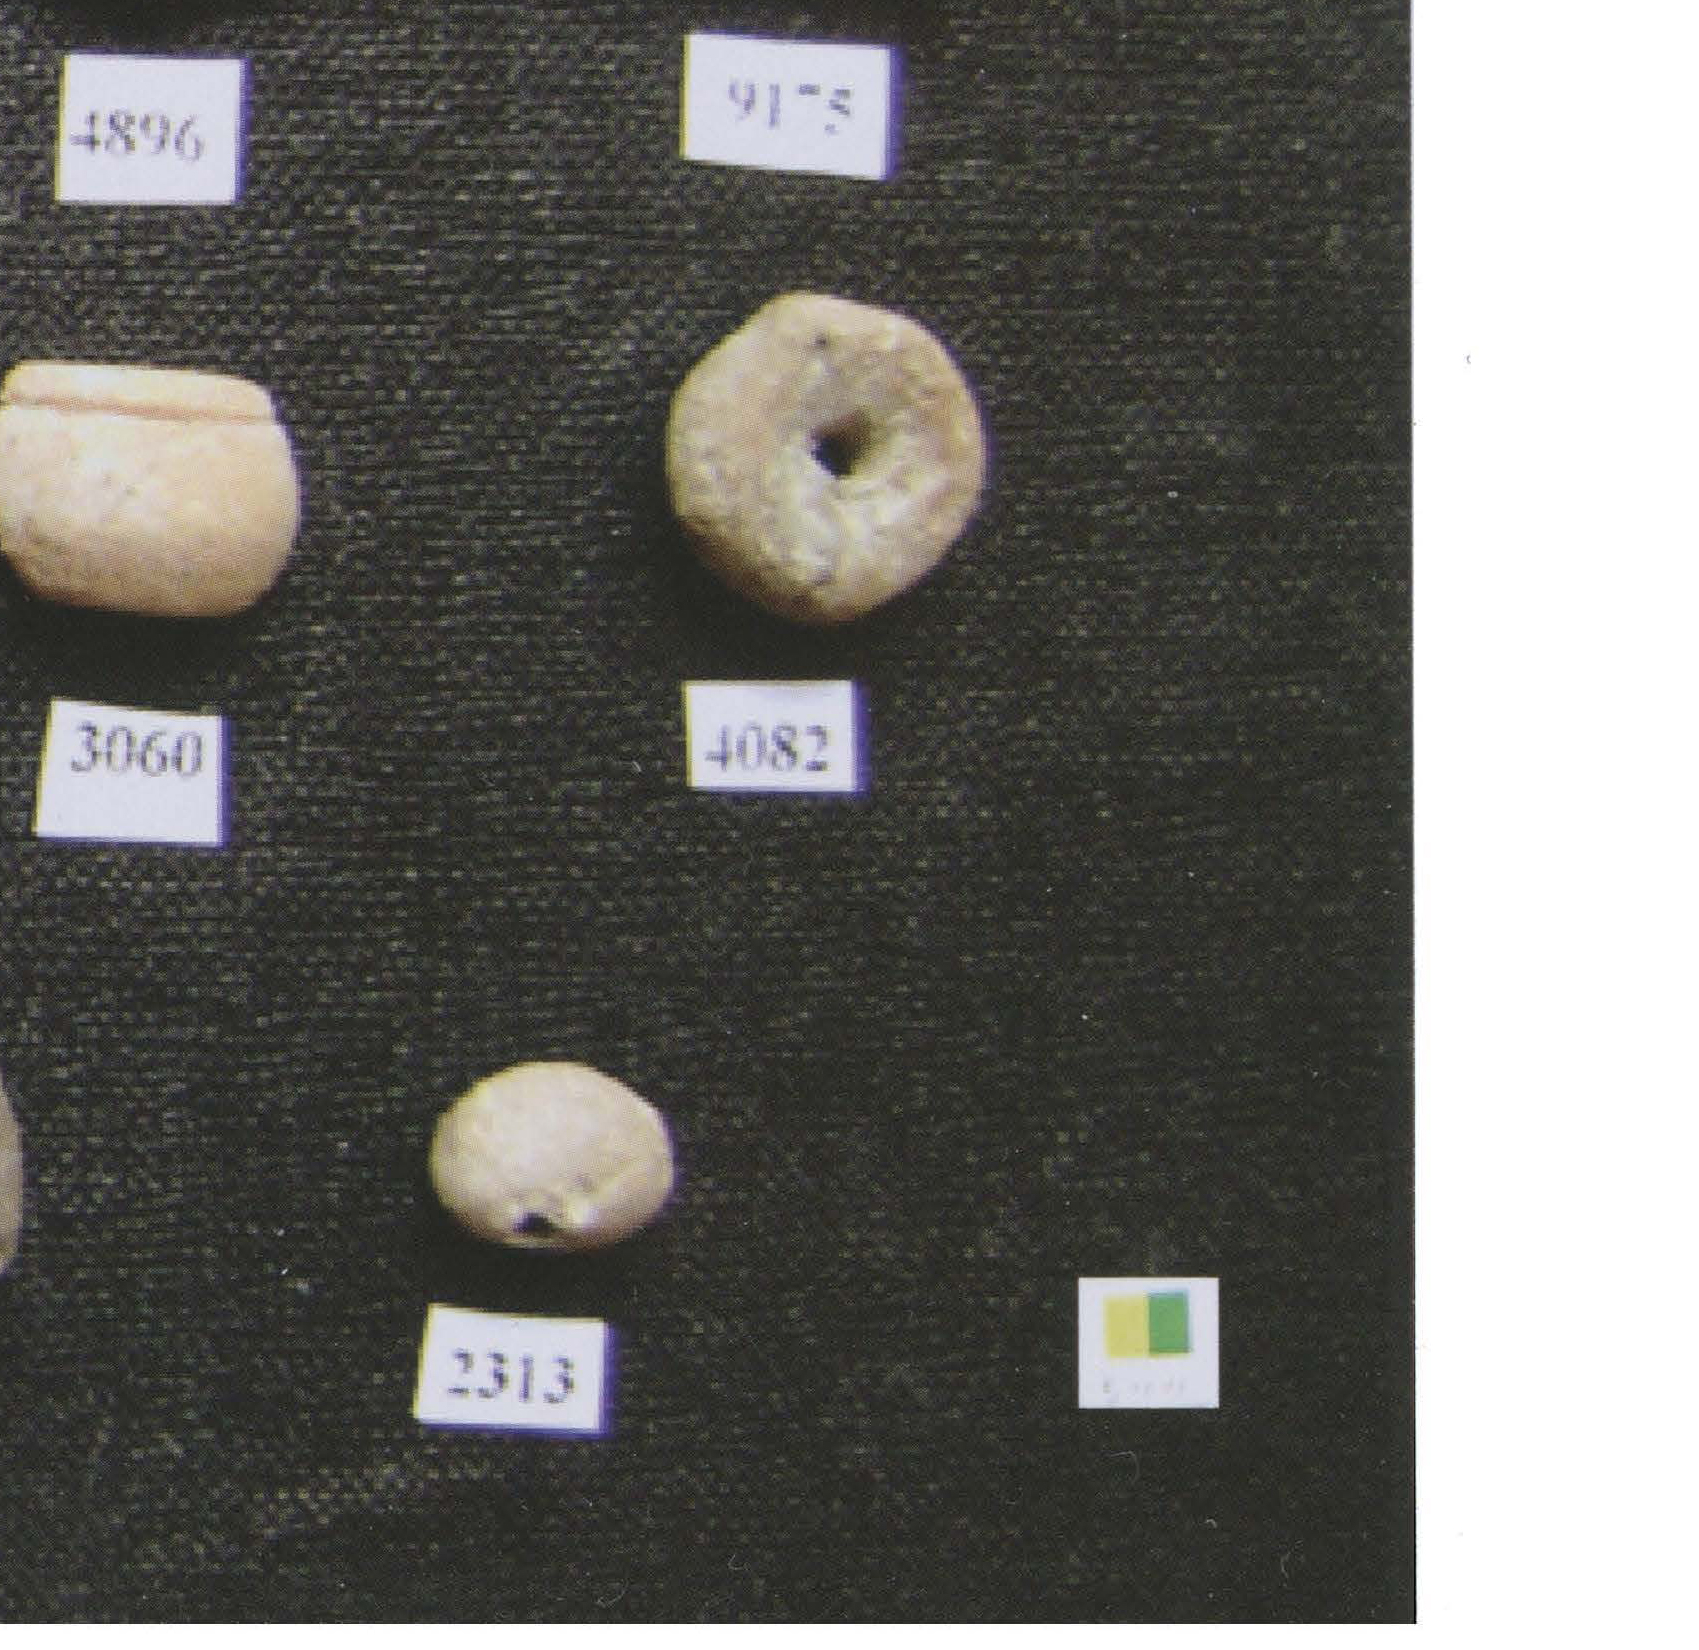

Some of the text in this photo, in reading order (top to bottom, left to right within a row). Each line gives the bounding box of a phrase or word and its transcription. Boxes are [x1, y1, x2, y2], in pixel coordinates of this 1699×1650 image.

[70, 109, 205, 166] 4896
[69, 720, 205, 778] 3060
[703, 723, 831, 775] 4082
[445, 1348, 577, 1406] 2313
